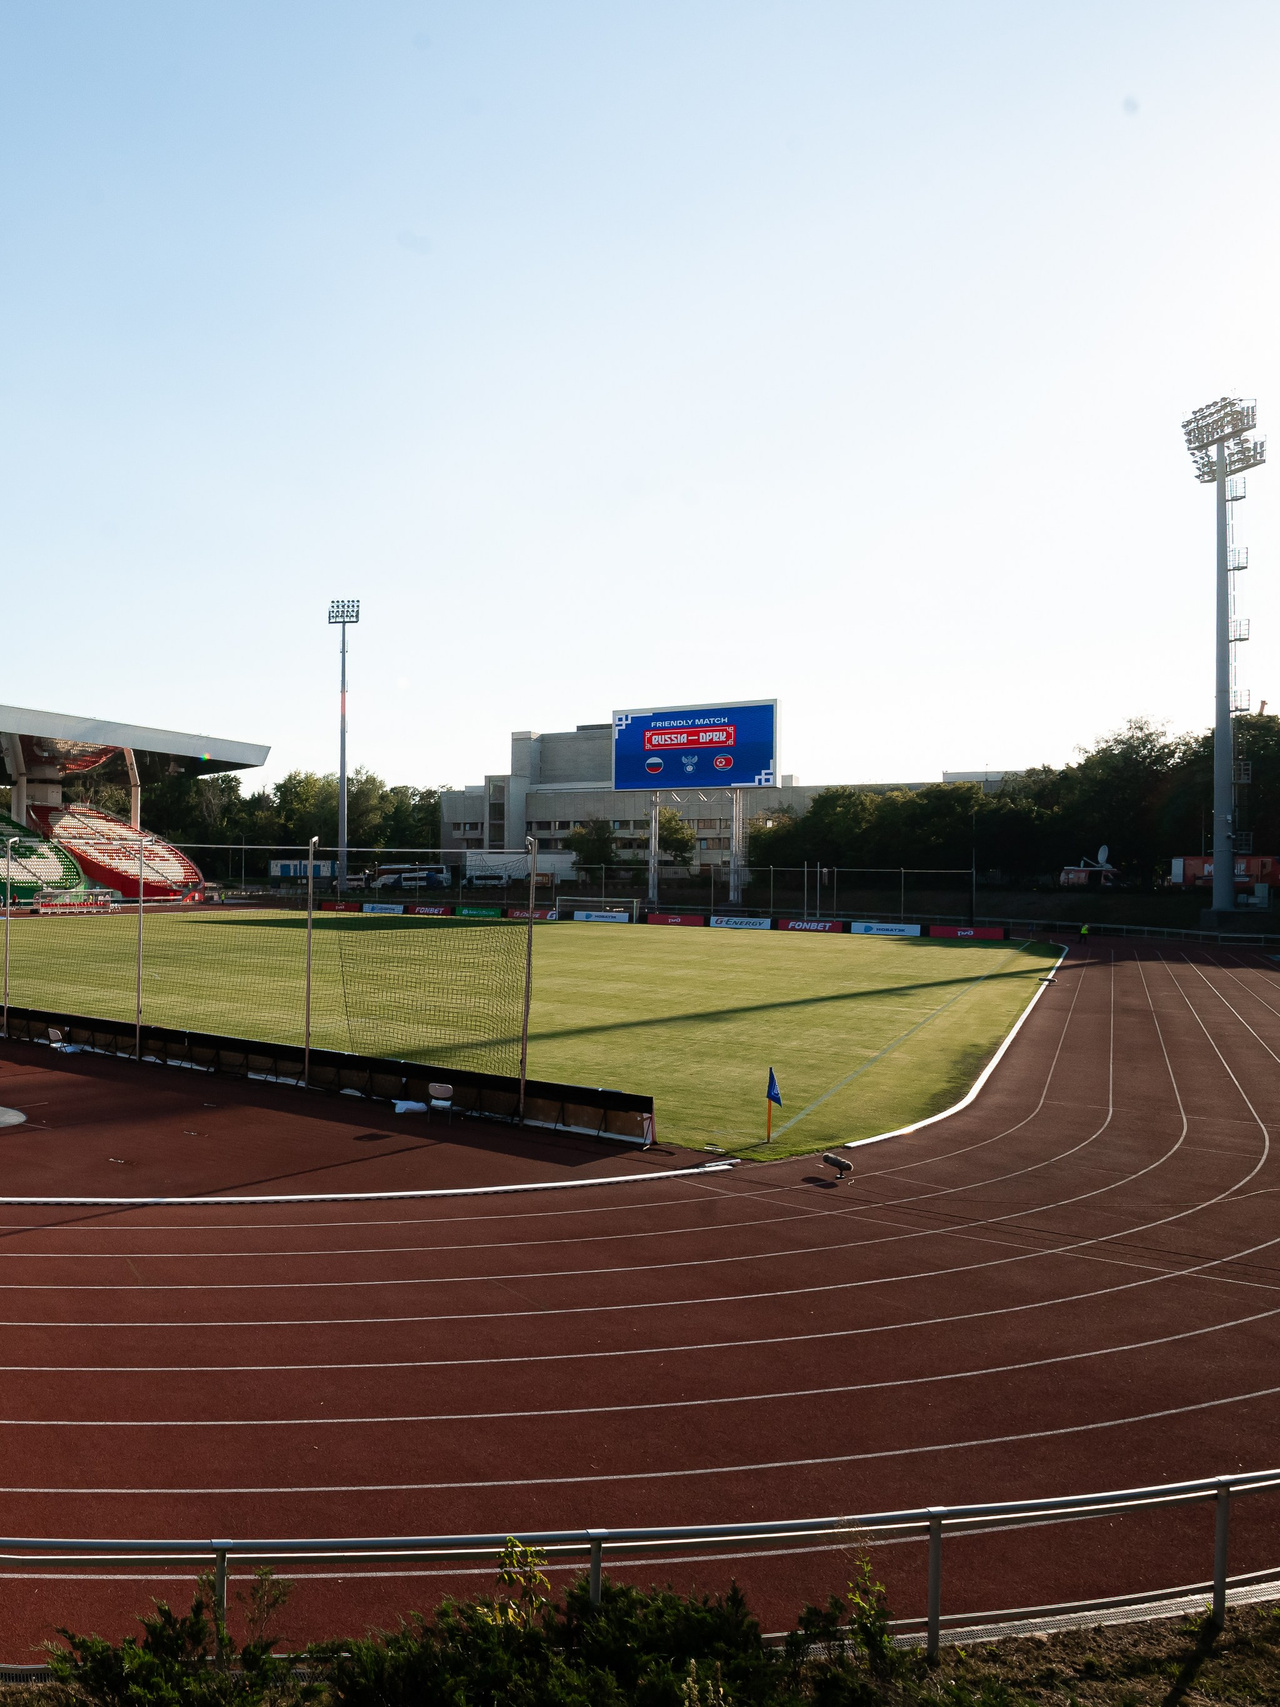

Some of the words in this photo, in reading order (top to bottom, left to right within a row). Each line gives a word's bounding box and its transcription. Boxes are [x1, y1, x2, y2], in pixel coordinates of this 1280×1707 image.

[651, 719, 693, 728] FRIENDLY
[695, 717, 728, 725] MATCH
[651, 733, 688, 745] RUSSIA
[699, 731, 727, 743] DPRK
[415, 907, 445, 915] FONBET
[788, 921, 832, 931] FONBET
